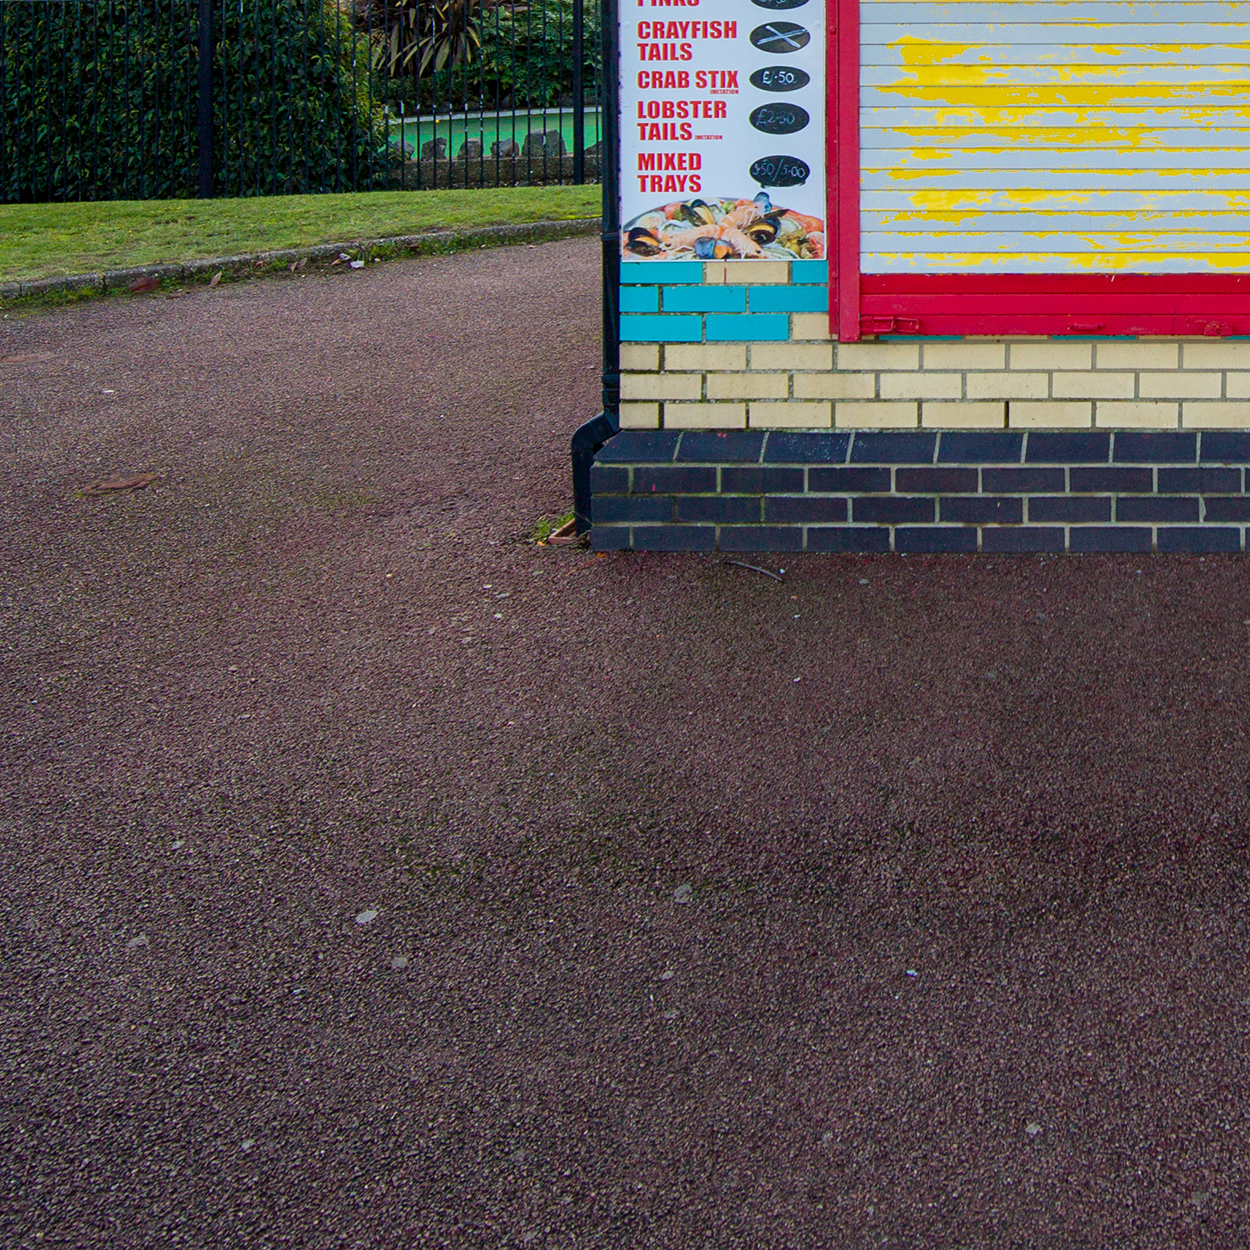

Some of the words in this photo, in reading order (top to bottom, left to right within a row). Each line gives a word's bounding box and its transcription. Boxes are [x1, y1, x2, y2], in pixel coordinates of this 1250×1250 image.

[637, 20, 737, 39] CRAYFISH
[637, 42, 693, 61] TAILS
[637, 70, 690, 89] CRAB
[695, 70, 739, 89] STIX
[637, 100, 727, 119] LOBSTER
[637, 122, 693, 141] TAILS
[637, 152, 701, 171] MIXED
[637, 174, 701, 193] TRAYS
